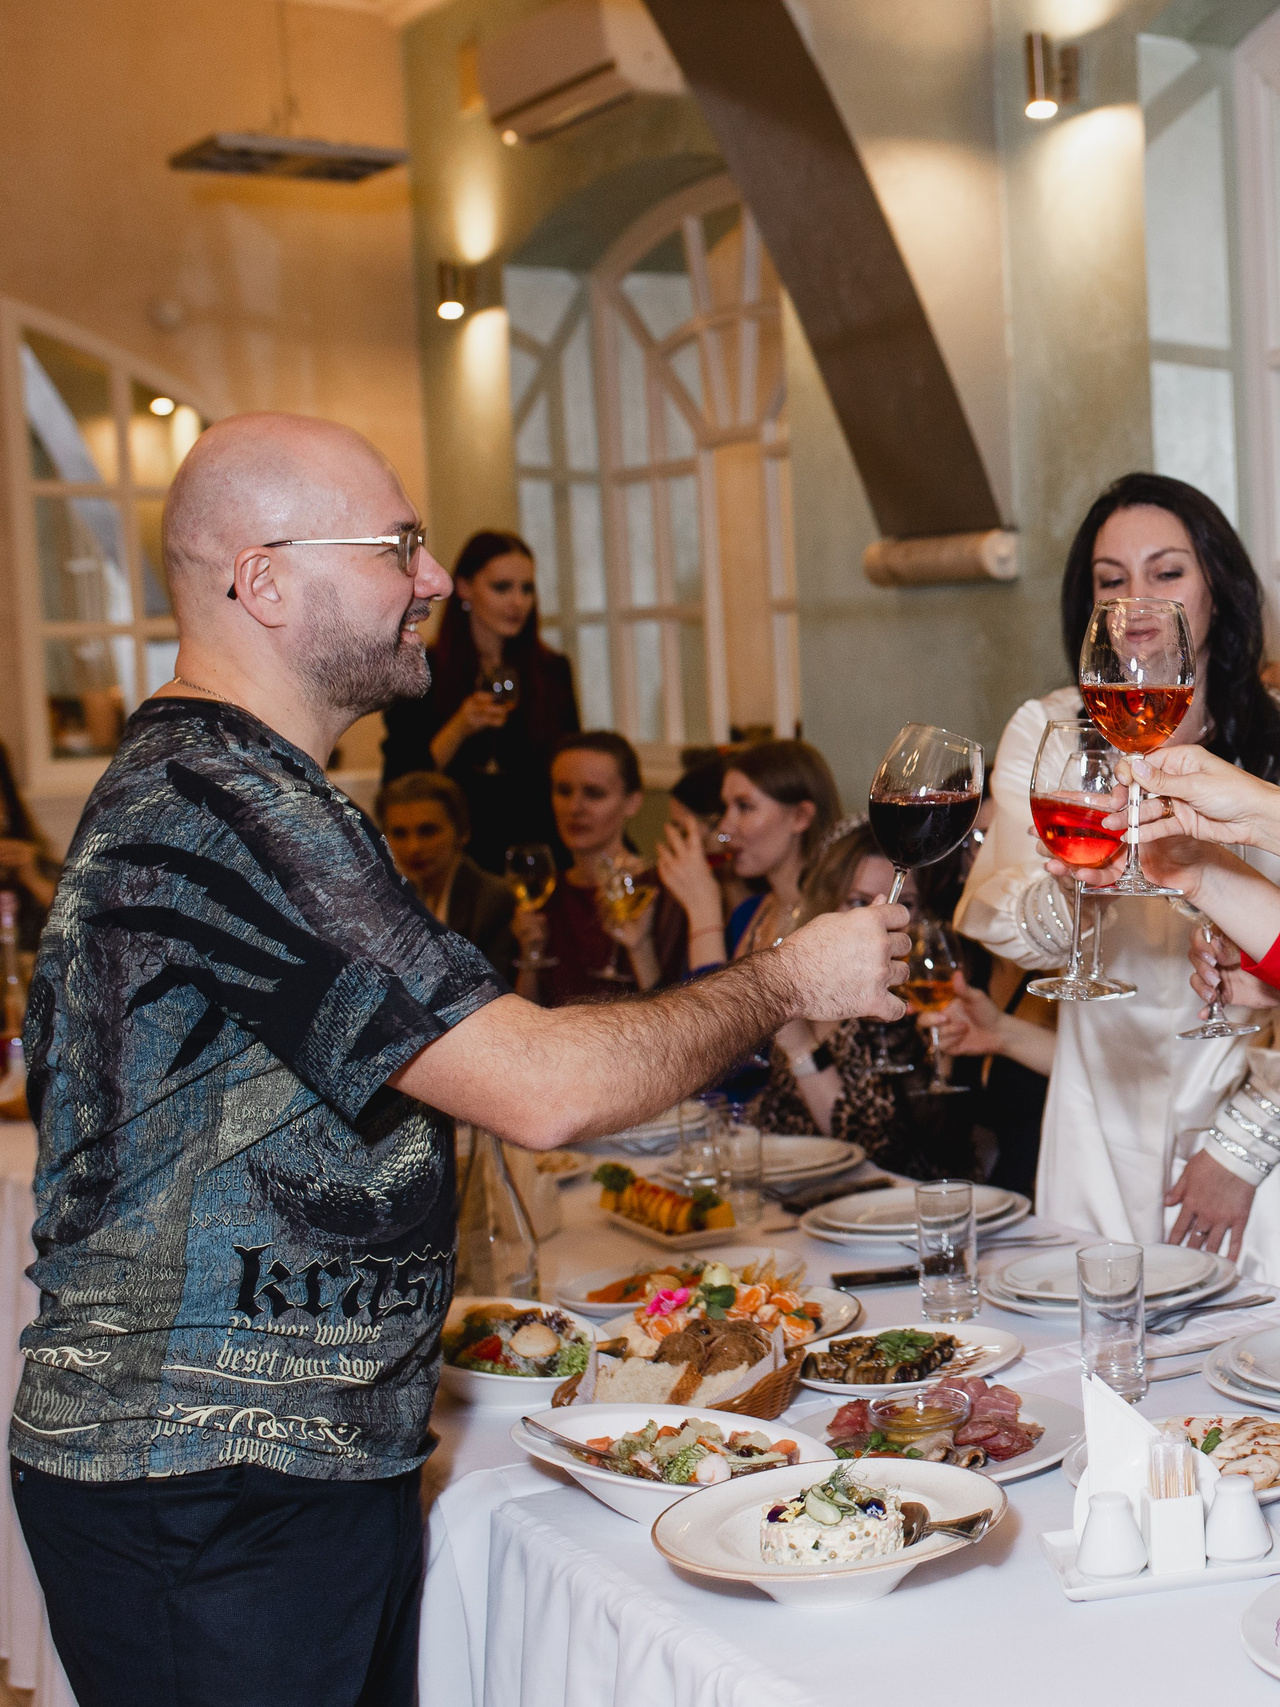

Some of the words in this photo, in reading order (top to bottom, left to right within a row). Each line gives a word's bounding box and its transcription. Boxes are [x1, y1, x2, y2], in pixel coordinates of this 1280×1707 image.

[214, 1338, 279, 1377] beset
[280, 1355, 331, 1379] your
[338, 1352, 384, 1380] door
[217, 1437, 297, 1474] appetite
